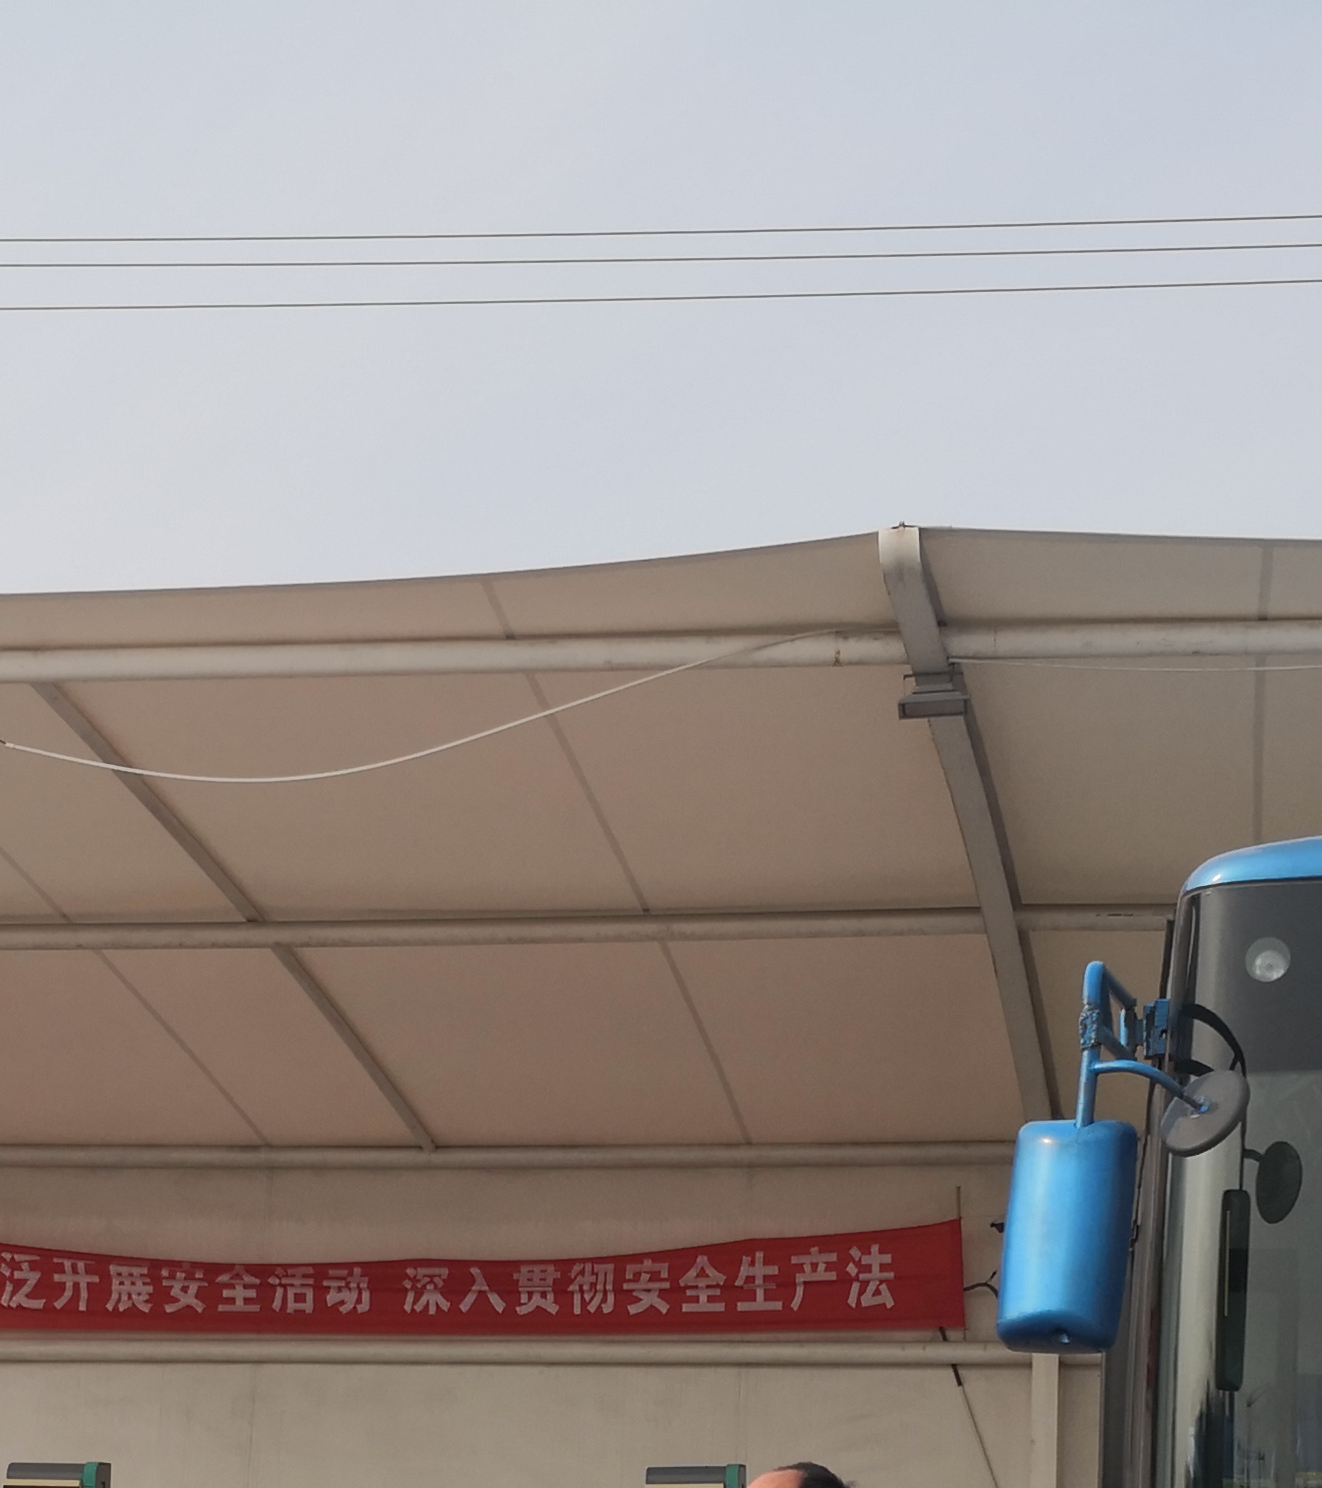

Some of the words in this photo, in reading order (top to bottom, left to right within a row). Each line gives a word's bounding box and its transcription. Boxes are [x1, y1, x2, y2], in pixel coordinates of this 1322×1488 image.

[402, 1243, 895, 1316] 深入贯彻安全生产法
